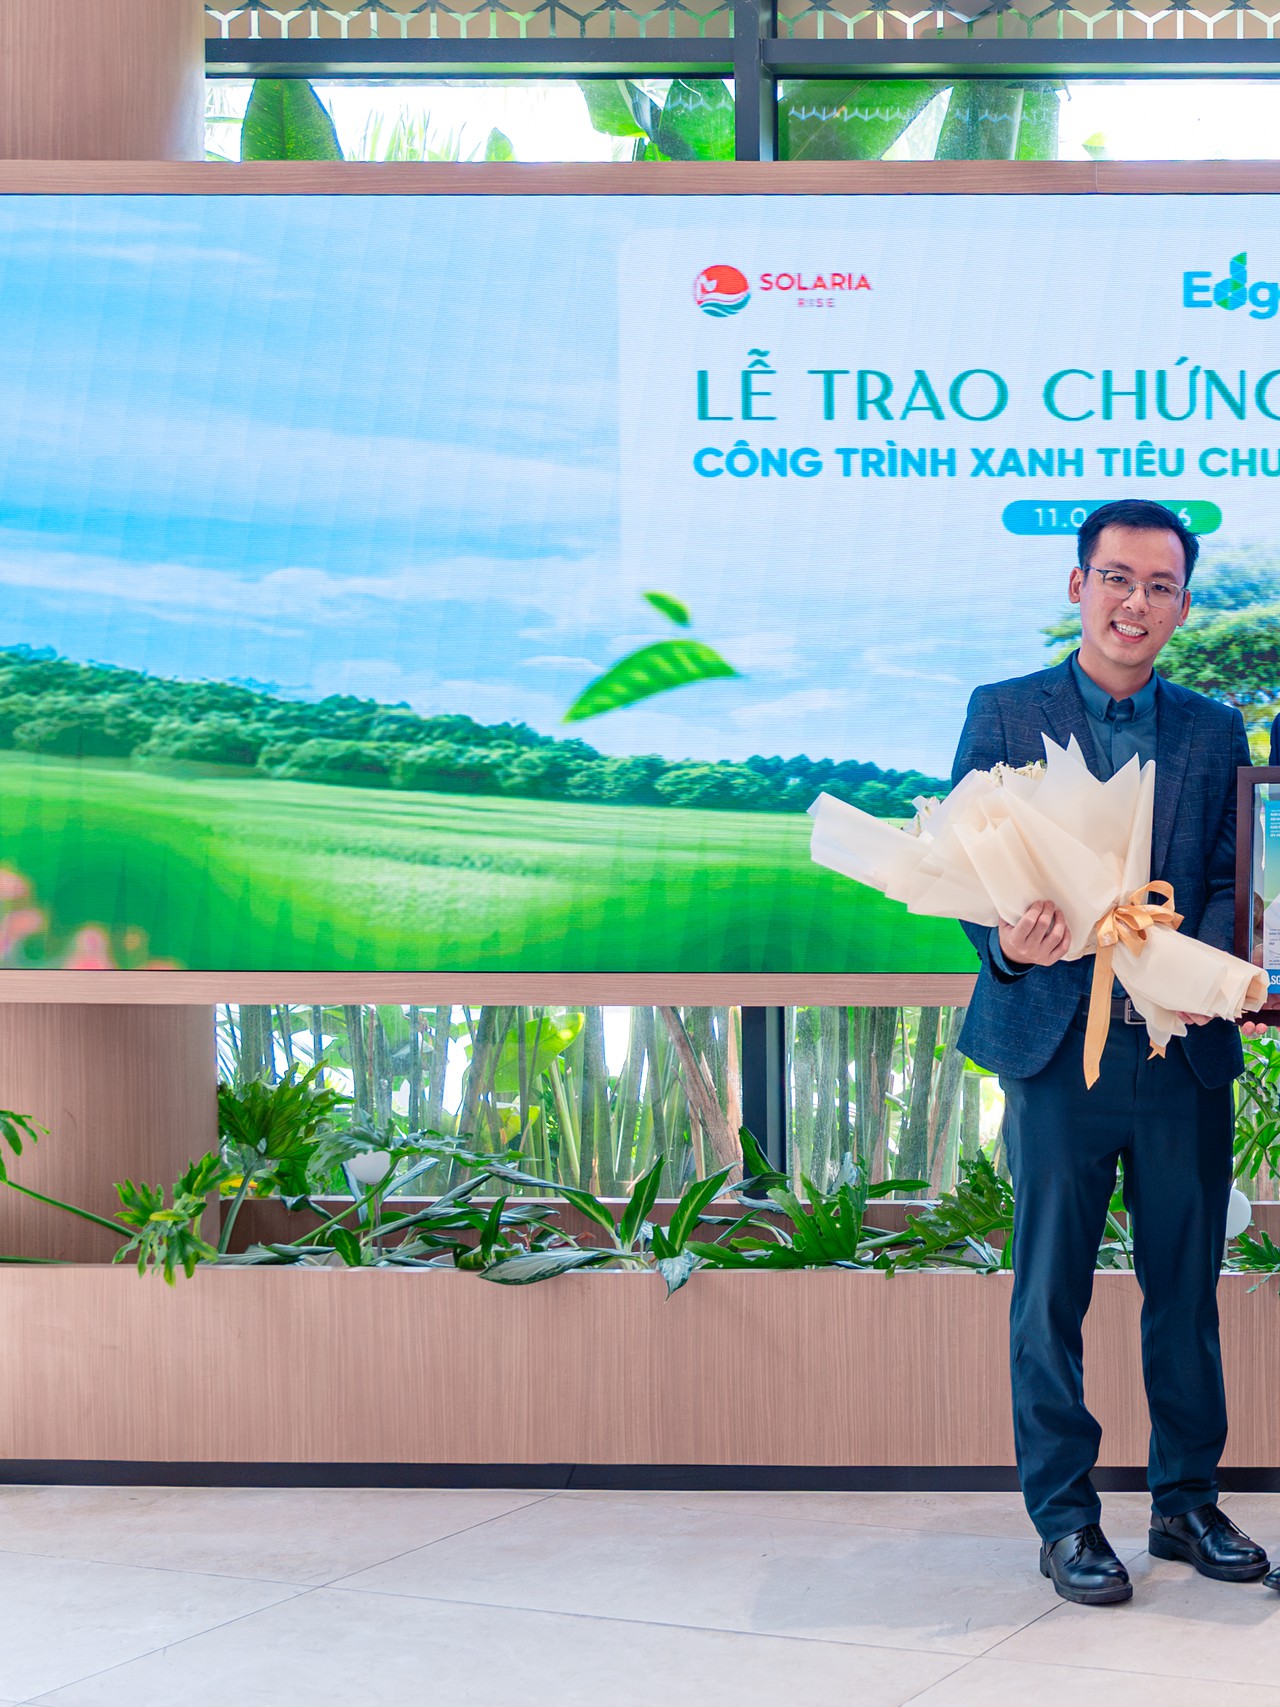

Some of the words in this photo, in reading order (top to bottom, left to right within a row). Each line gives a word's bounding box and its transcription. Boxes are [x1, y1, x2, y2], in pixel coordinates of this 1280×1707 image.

[759, 272, 872, 292] SOLARIA
[797, 297, 836, 308] RISE
[696, 347, 778, 421] LỄ
[806, 368, 1010, 422] TRAO
[692, 439, 824, 478] CÔNG
[834, 439, 957, 478] TRÌNH
[969, 447, 1085, 478] XANH
[1096, 440, 1186, 478] TIÊU
